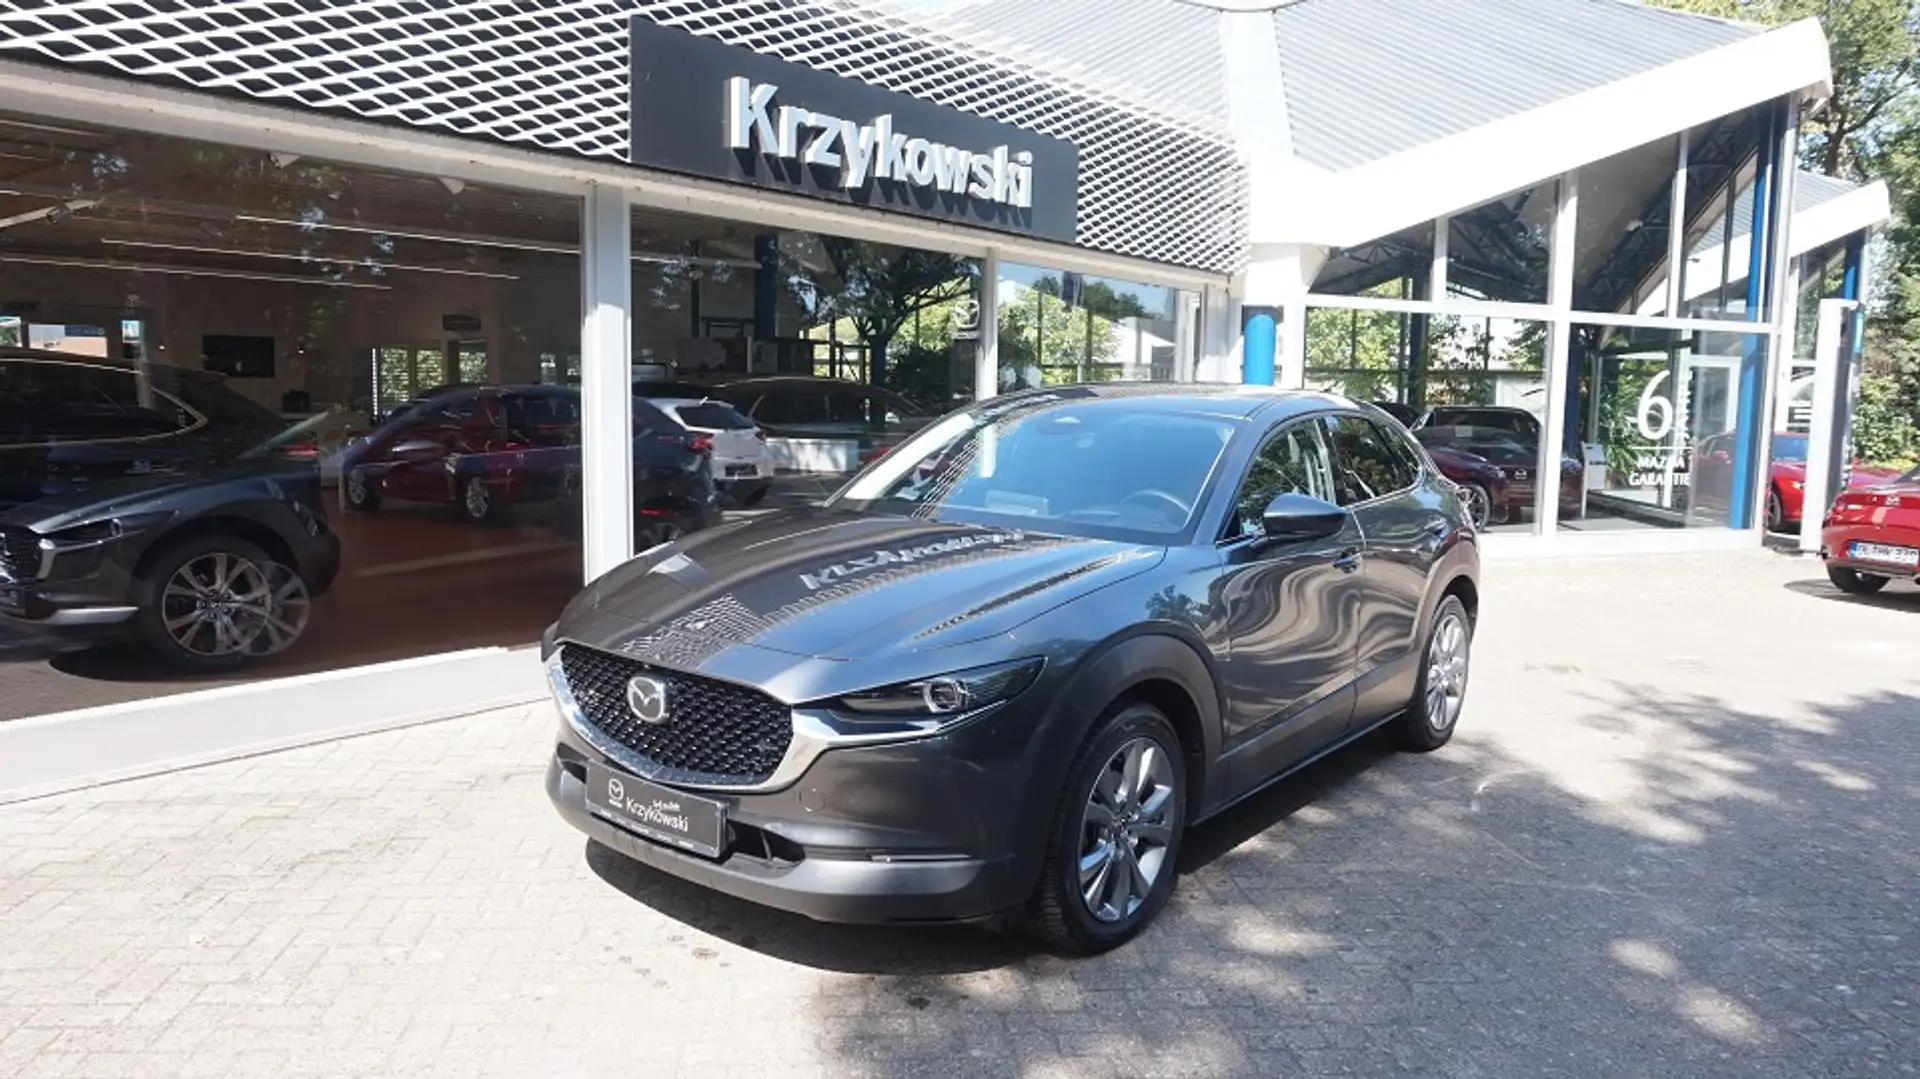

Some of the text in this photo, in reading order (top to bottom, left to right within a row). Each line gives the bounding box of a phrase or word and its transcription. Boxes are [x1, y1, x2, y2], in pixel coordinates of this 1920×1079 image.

[727, 76, 1034, 208] Krzykowski
[1638, 369, 1673, 440] 6
[1629, 472, 1691, 486] GARATIE
[1636, 455, 1685, 469] MAZA
